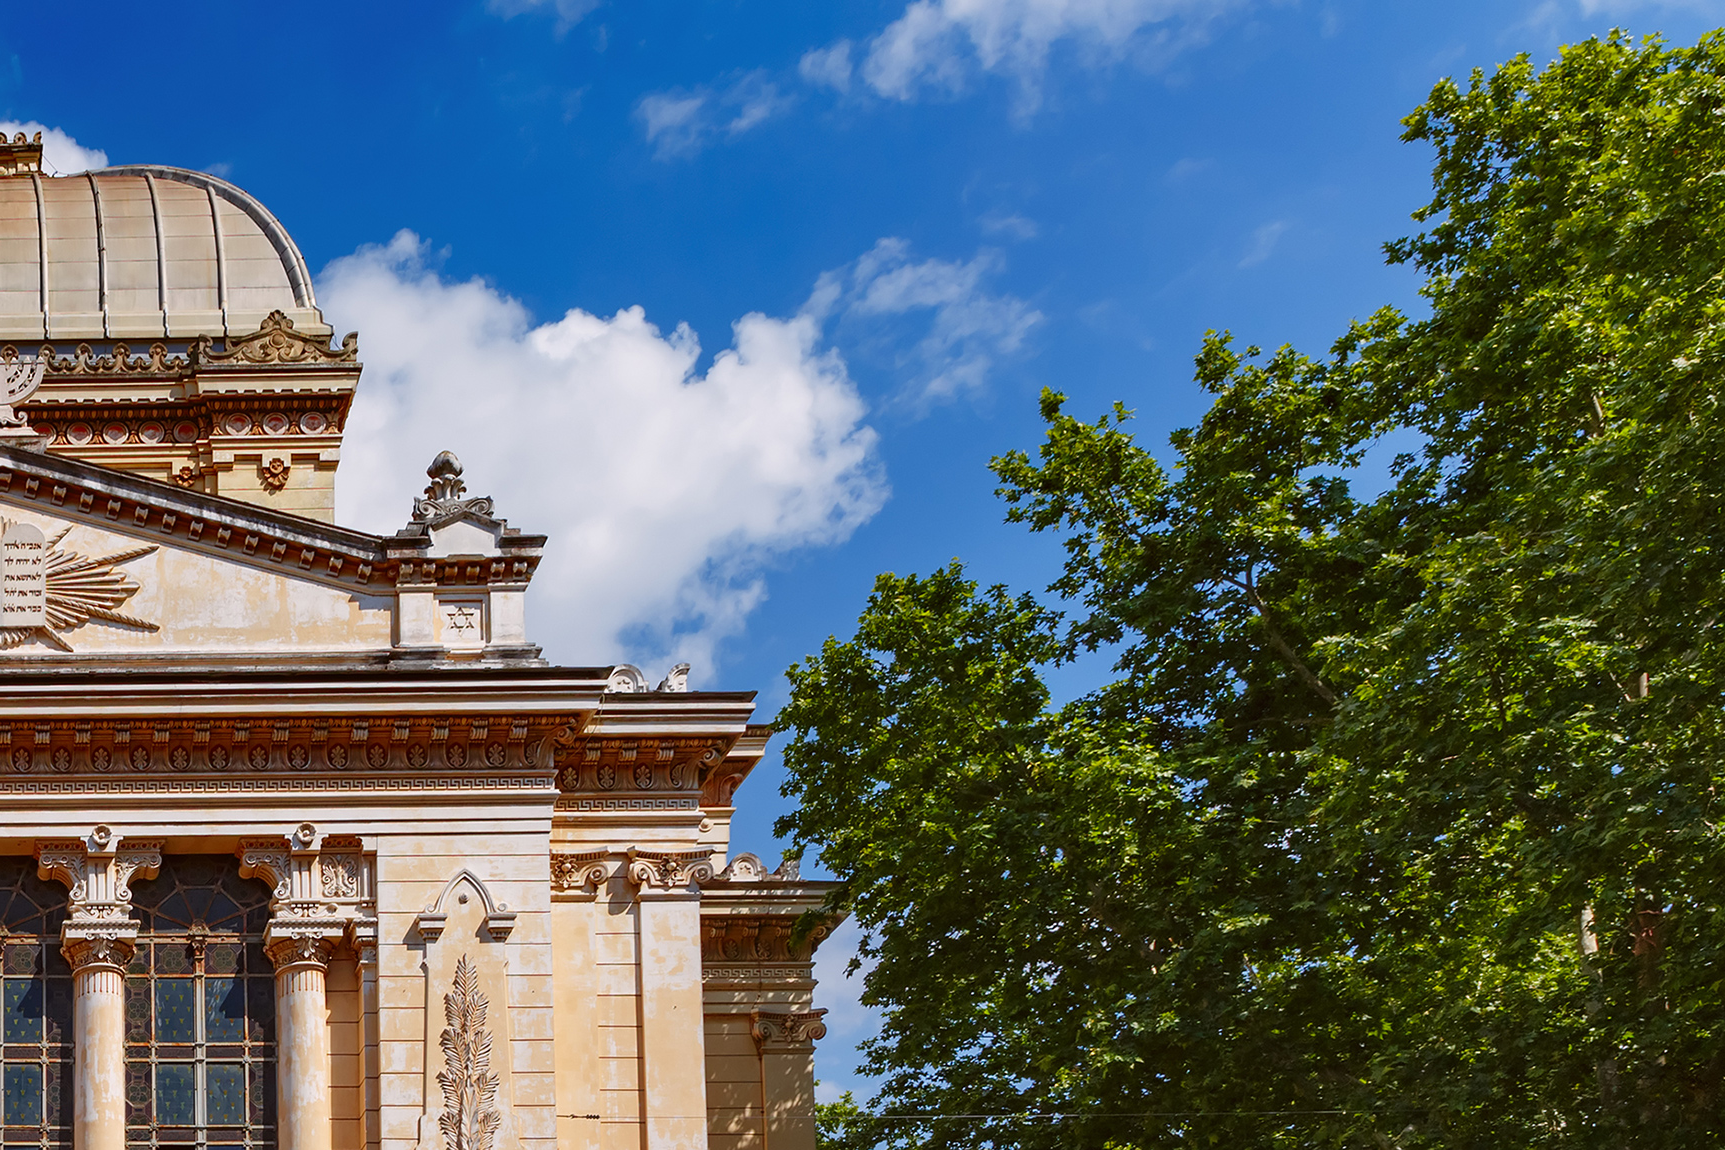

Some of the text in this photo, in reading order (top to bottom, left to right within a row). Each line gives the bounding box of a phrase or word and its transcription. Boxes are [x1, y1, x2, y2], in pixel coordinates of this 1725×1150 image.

[5, 557, 13, 566] לך
[32, 556, 41, 565] לא
[31, 572, 41, 580] לא
